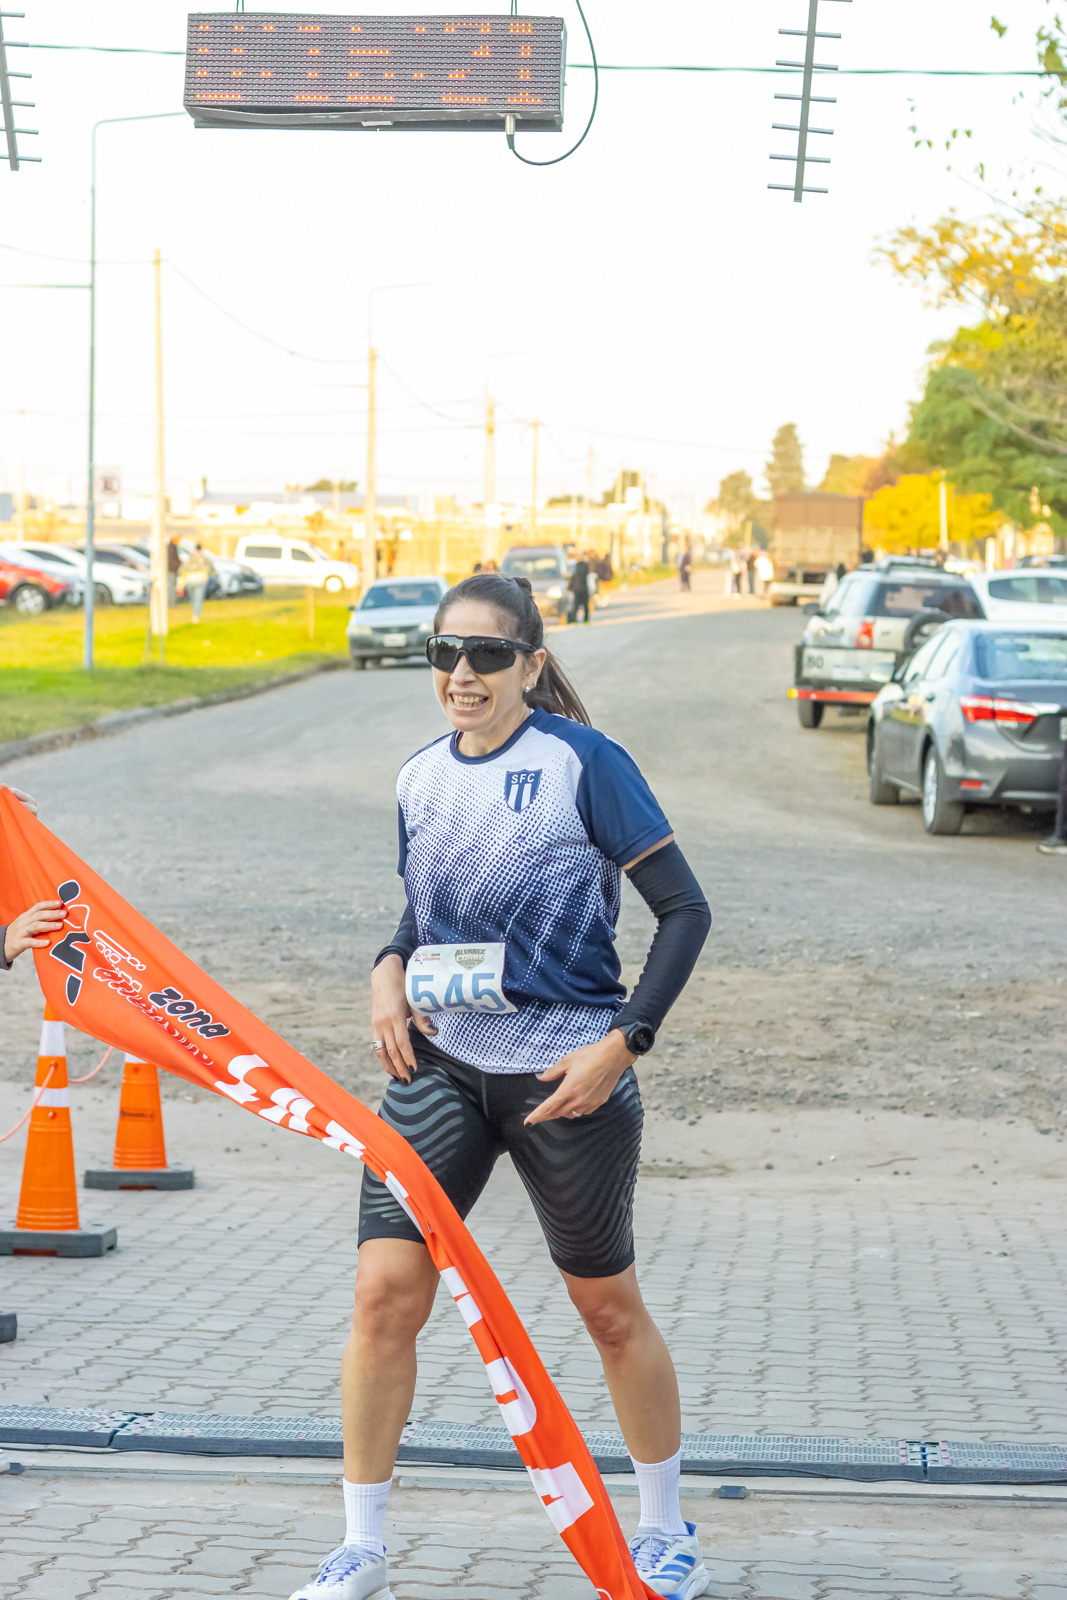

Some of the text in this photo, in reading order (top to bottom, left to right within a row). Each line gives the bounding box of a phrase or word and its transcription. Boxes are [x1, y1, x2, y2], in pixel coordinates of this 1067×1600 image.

[511, 773, 535, 784] SFC
[456, 954, 485, 962] CORRE
[411, 973, 507, 1013] 545
[148, 986, 232, 1039] zona
